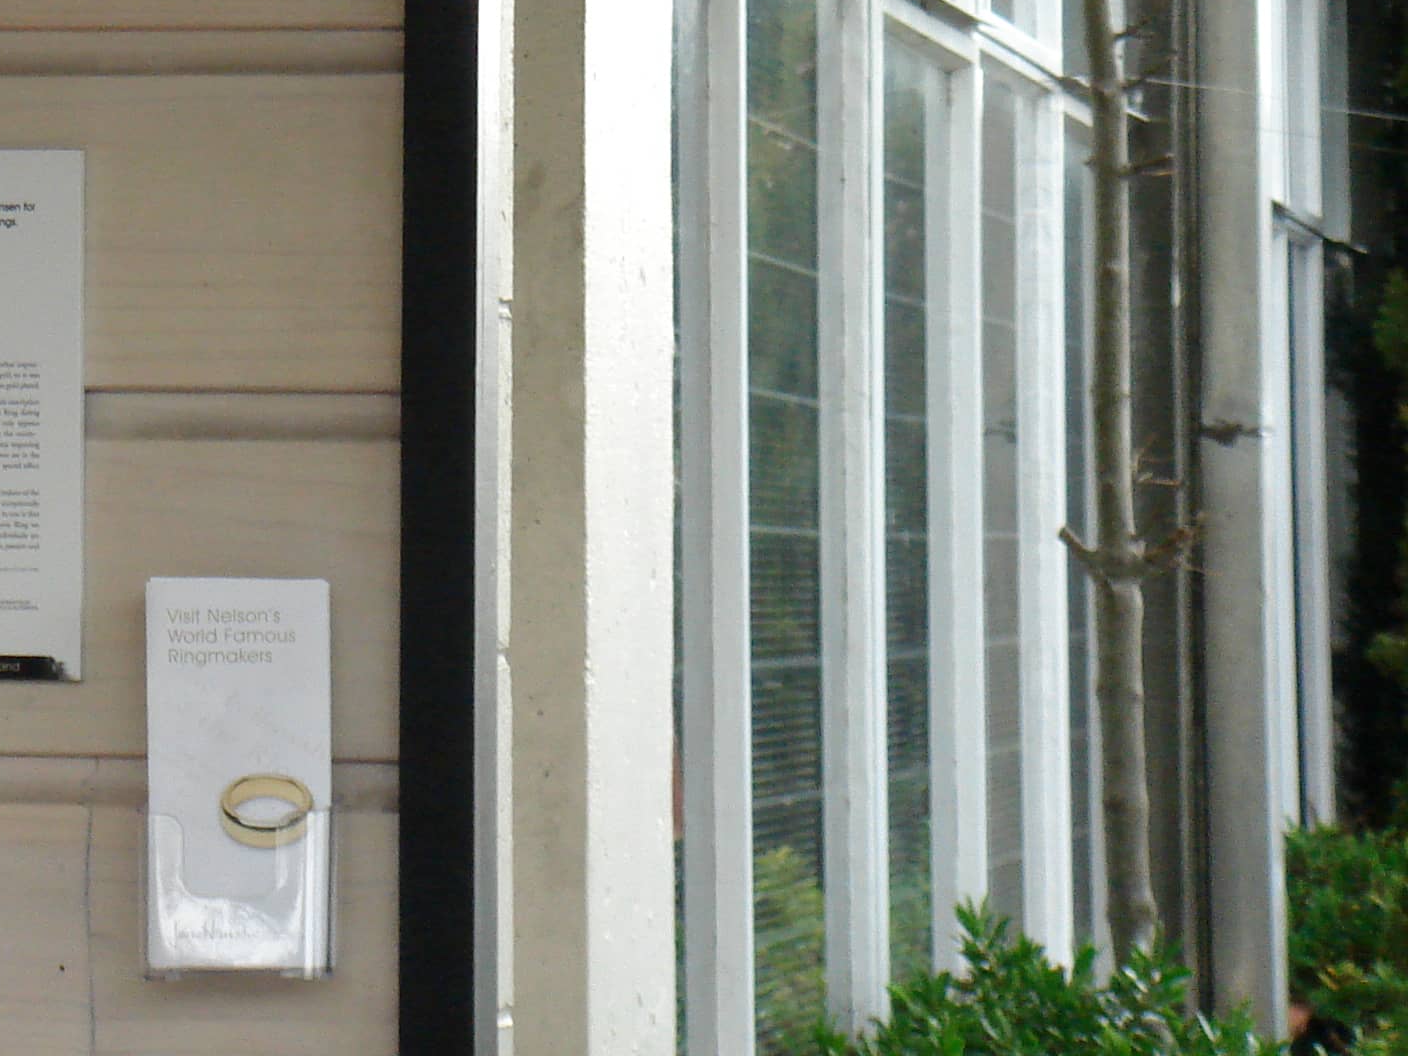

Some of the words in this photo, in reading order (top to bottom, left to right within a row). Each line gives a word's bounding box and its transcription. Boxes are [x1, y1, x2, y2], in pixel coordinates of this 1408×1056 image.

[166, 608, 200, 624] Visit
[207, 608, 281, 624] Nelson's
[168, 628, 218, 644] World
[224, 628, 297, 644] Famous
[168, 648, 273, 666] Ringmakers
